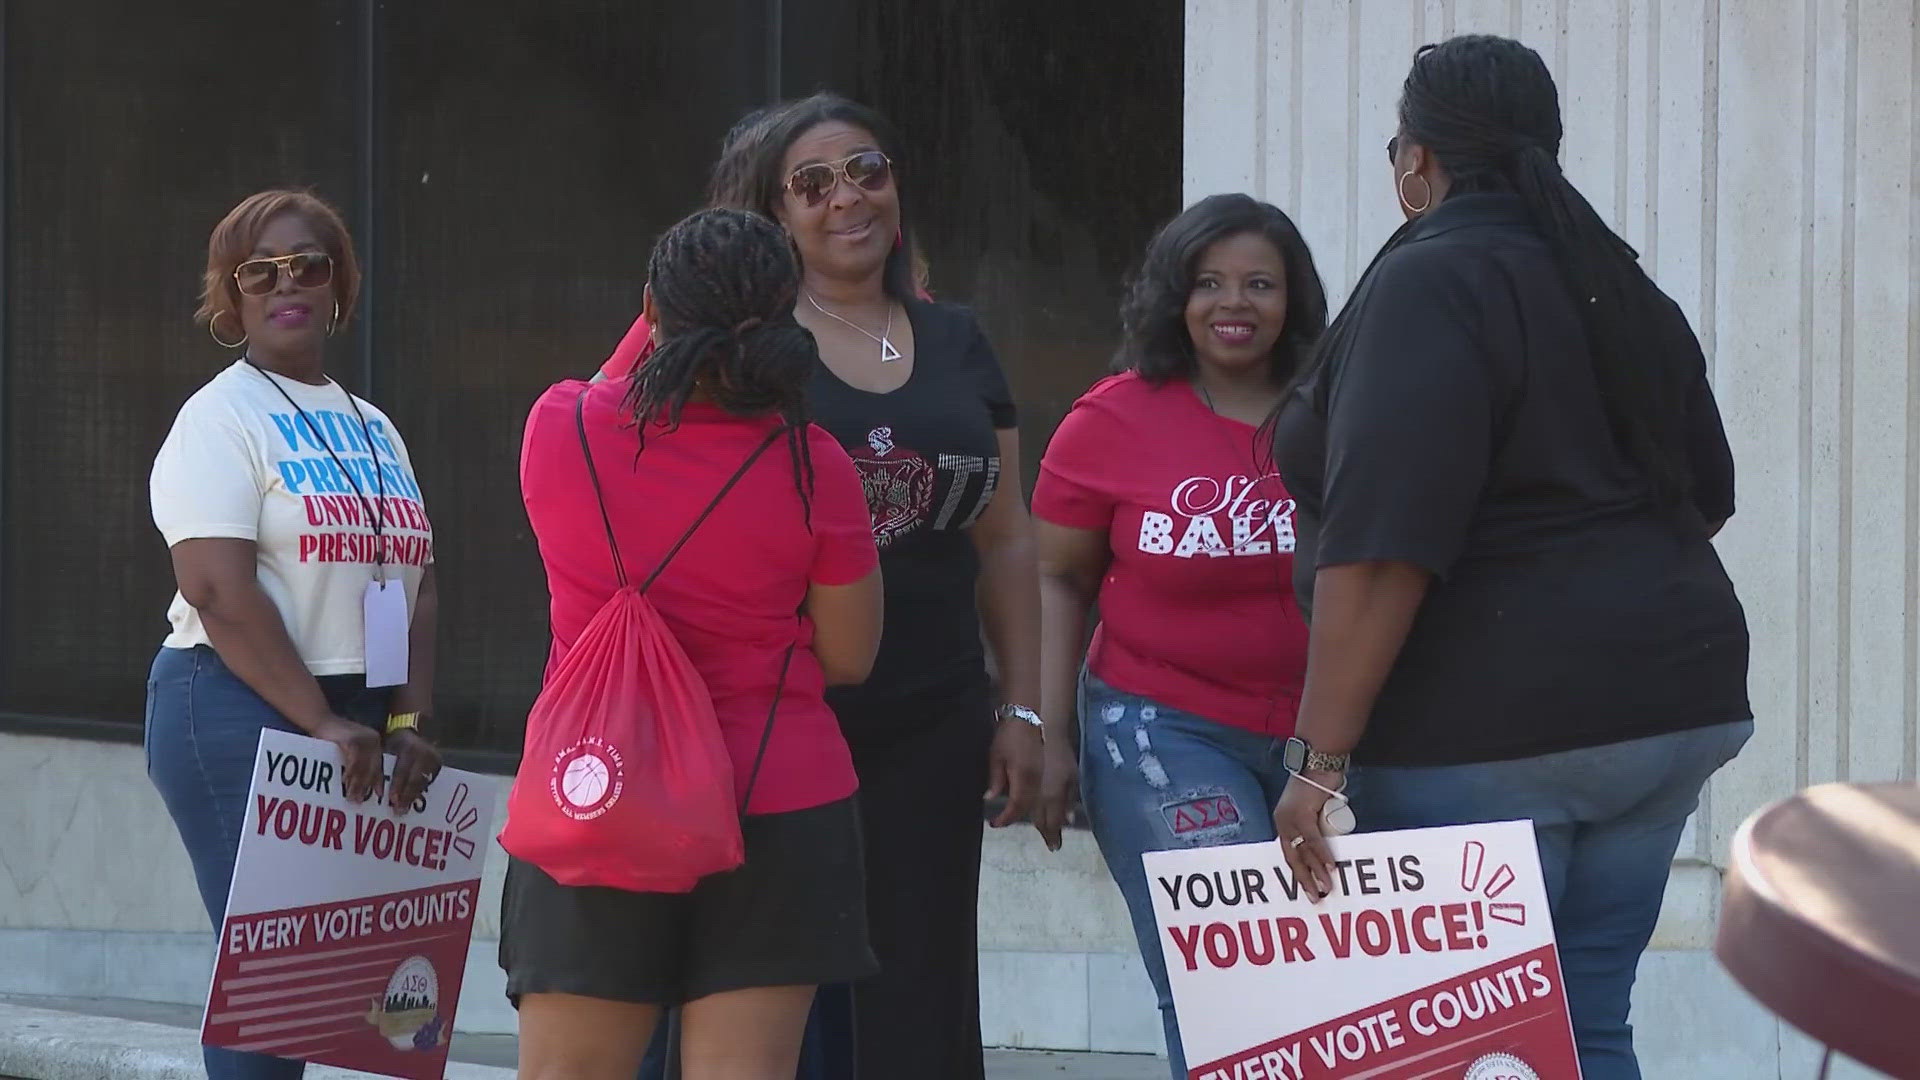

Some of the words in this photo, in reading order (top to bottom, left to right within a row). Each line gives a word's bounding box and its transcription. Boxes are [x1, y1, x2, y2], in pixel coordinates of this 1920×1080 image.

[269, 410, 398, 462] VOTING
[267, 750, 333, 794] YOUR
[257, 794, 346, 850] YOUR
[354, 814, 452, 871] VOICE!
[1158, 868, 1269, 911] YOUR
[1273, 858, 1381, 902] VTE
[1387, 855, 1425, 892] IS
[228, 913, 308, 955] EVERY
[312, 905, 375, 942] VOTE
[379, 888, 471, 933] COUNTS
[1167, 916, 1316, 972] YOUR
[1318, 900, 1488, 959] VOICE!
[1309, 1009, 1406, 1070] VOTE
[1408, 959, 1552, 1036] COUNTS
